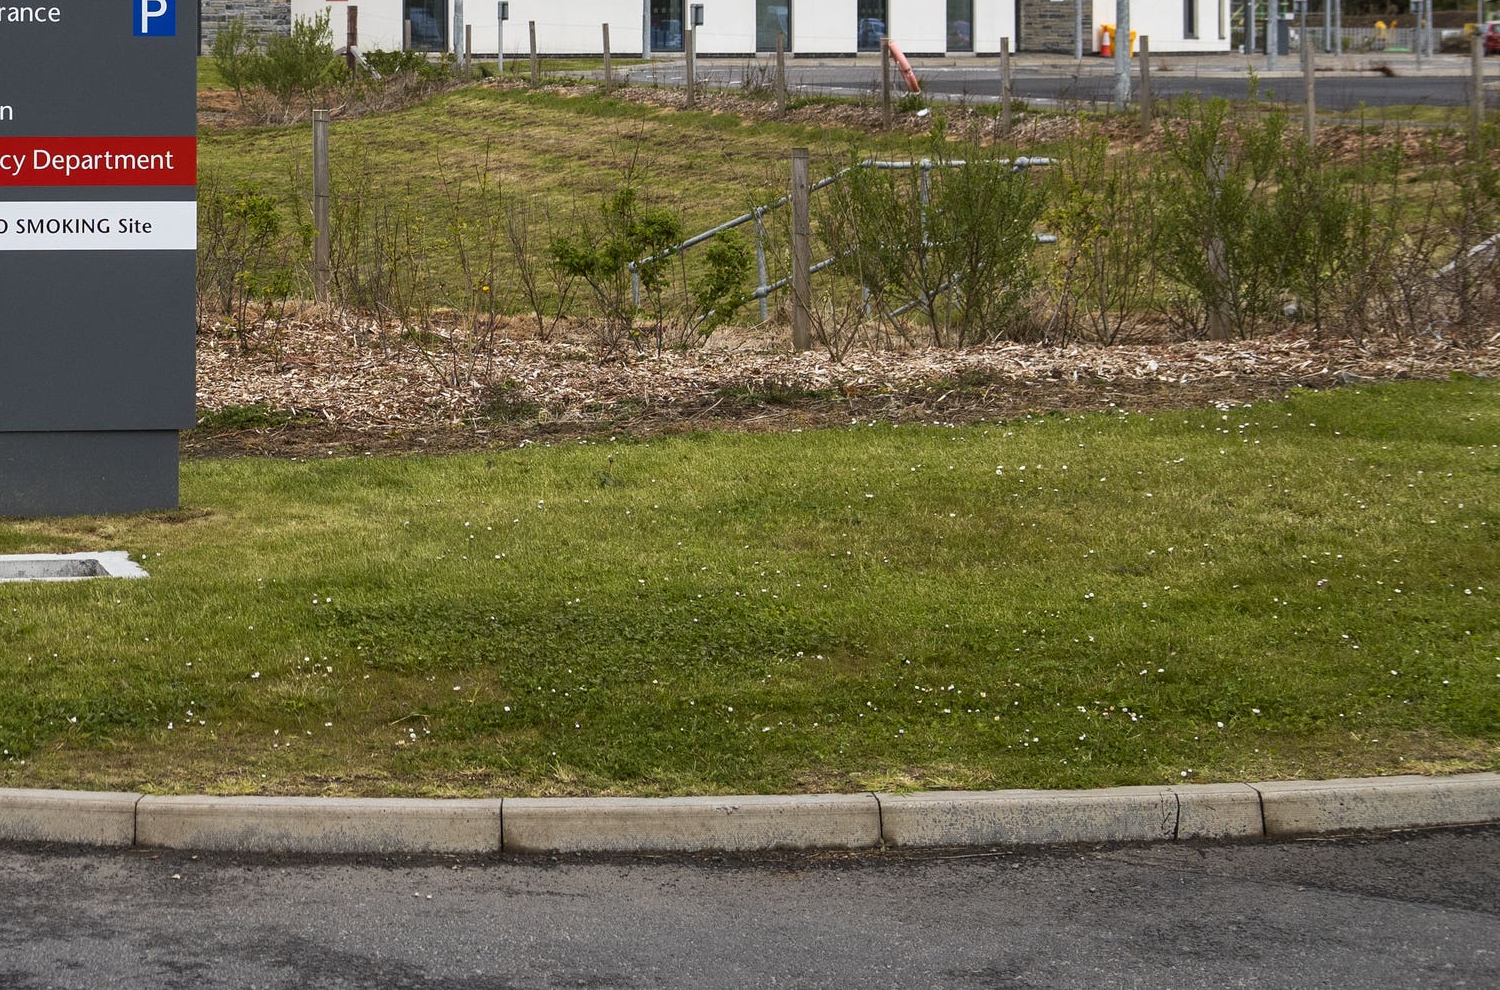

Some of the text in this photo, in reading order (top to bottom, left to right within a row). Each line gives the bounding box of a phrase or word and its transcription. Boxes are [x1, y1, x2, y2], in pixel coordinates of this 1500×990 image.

[34, 150, 174, 176] Department
[17, 219, 109, 233] SMOKING
[119, 218, 151, 233] Site
